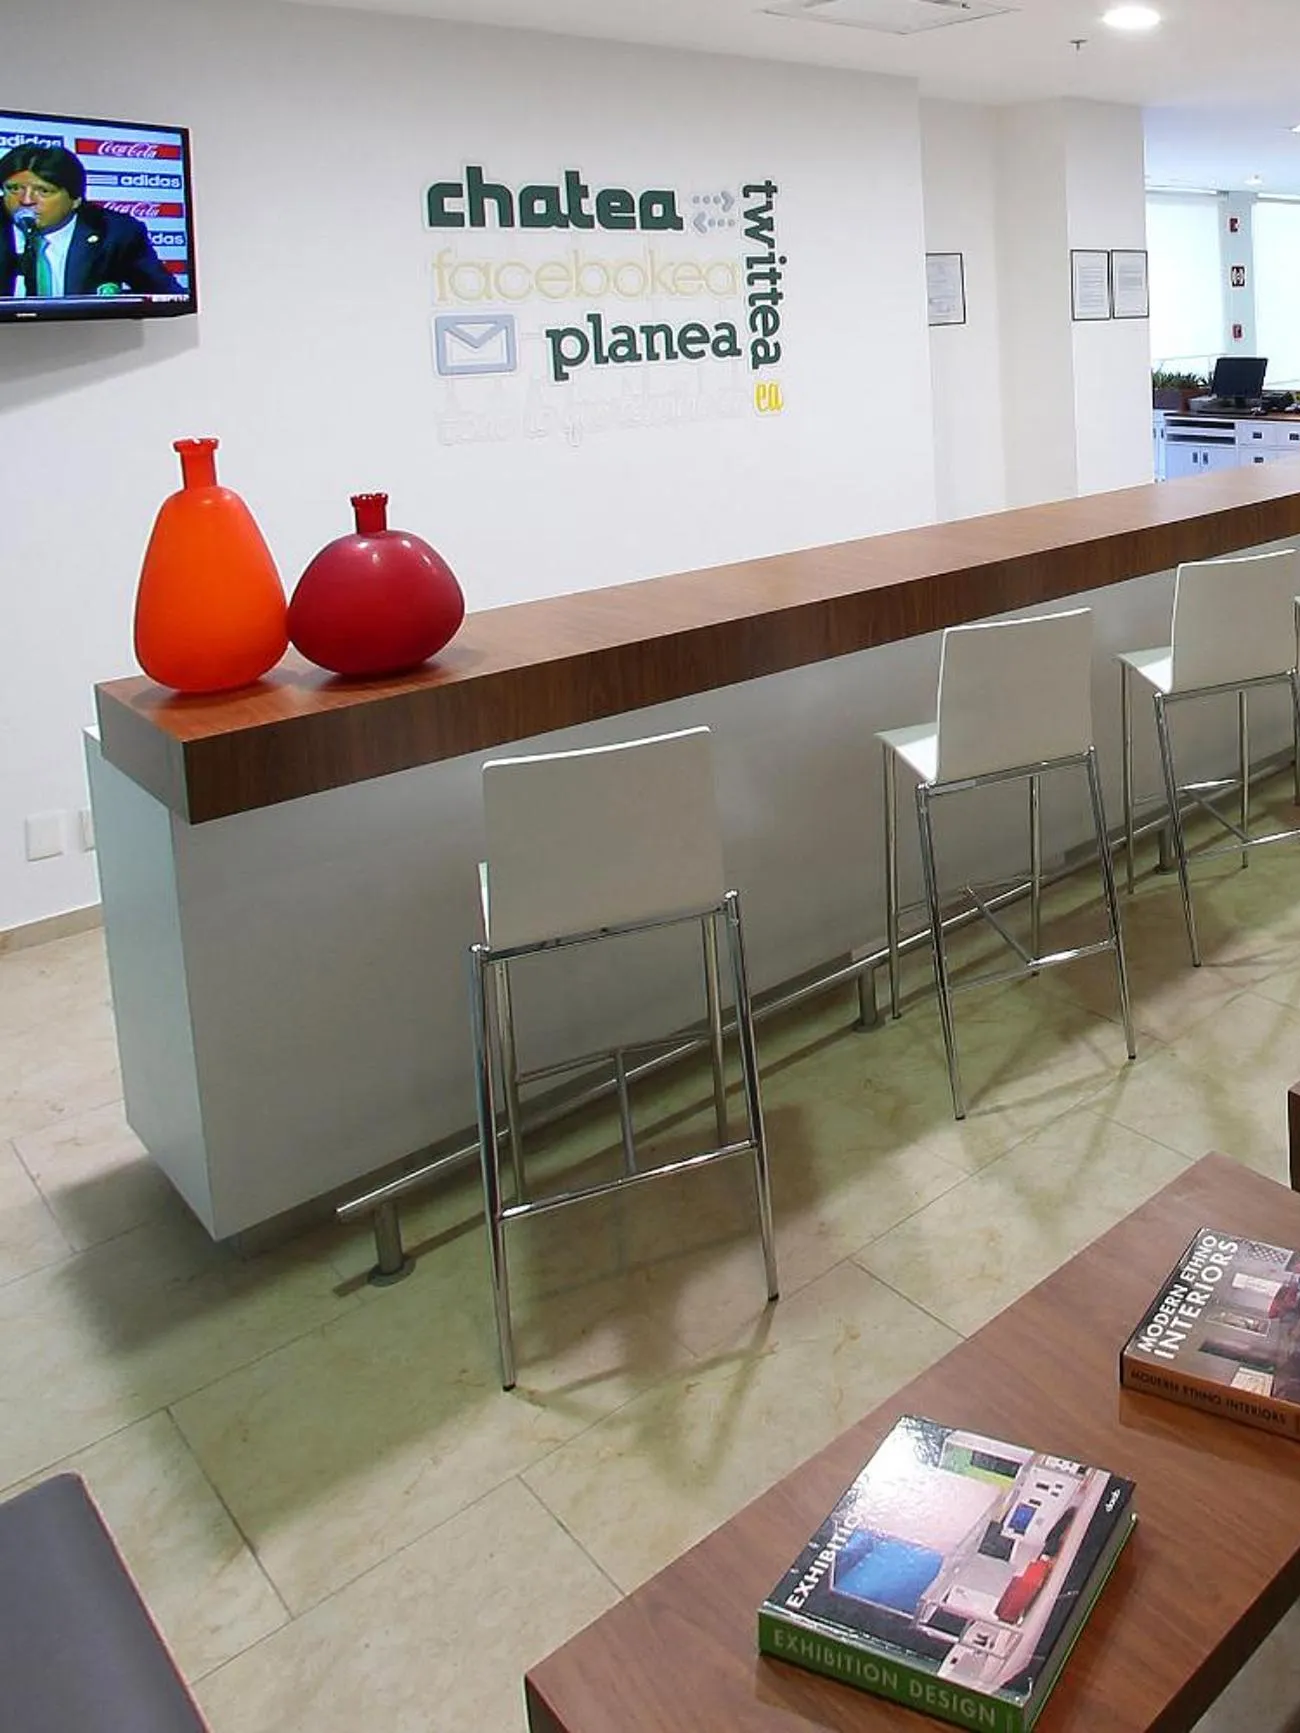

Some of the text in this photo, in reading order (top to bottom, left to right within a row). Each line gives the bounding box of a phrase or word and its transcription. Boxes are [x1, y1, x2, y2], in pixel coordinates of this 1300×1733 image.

[120, 174, 181, 188] adidas
[427, 165, 684, 230] chatea
[741, 179, 787, 370] twittea
[545, 313, 743, 382] planea
[1137, 1235, 1217, 1352] MODERN ETHNO
[1154, 1240, 1239, 1360] INTERIORS
[1130, 1368, 1180, 1392] MODERN
[1226, 1399, 1286, 1426] INTERIORS
[785, 1507, 862, 1609] EXHIBITIO
[774, 1628, 997, 1727] EXHIBITION DESIGN
